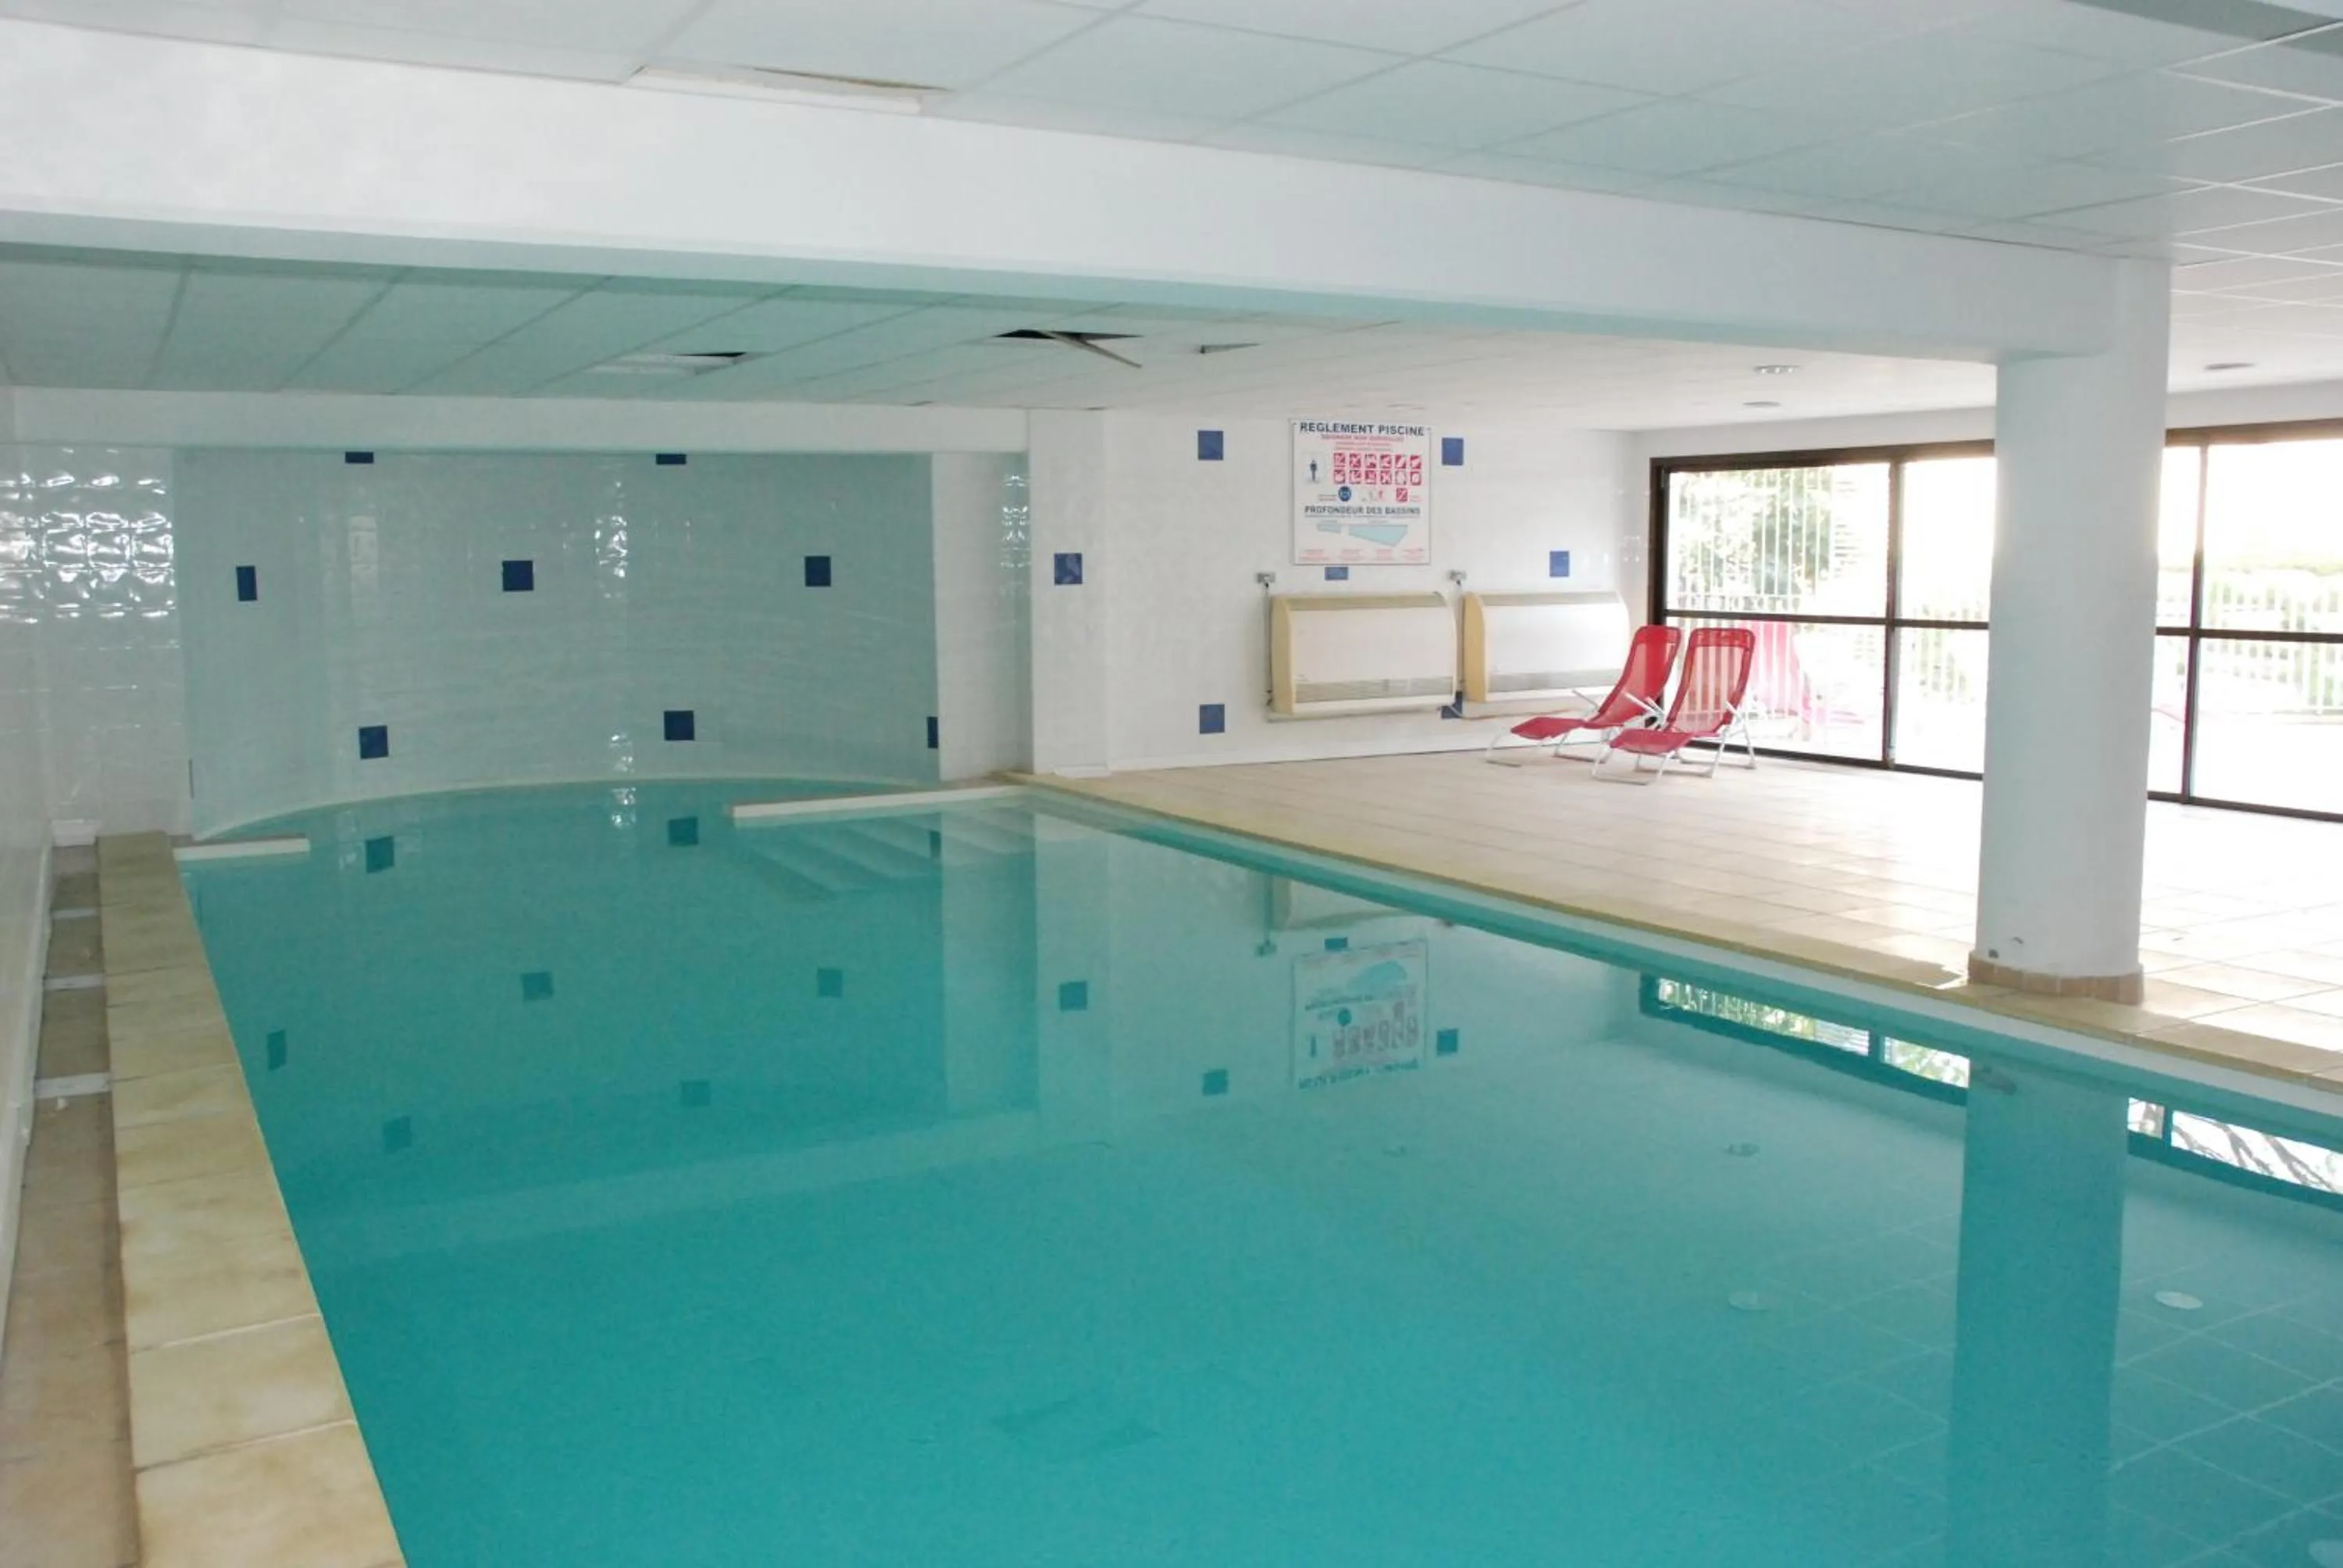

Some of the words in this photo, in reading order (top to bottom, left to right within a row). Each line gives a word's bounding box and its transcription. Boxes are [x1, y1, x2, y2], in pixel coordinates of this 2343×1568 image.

[1300, 422, 1375, 434] REGLEMENT
[1378, 424, 1425, 437] PISCINE
[1304, 505, 1364, 514] PROFONDEUR
[1366, 505, 1383, 515] DES
